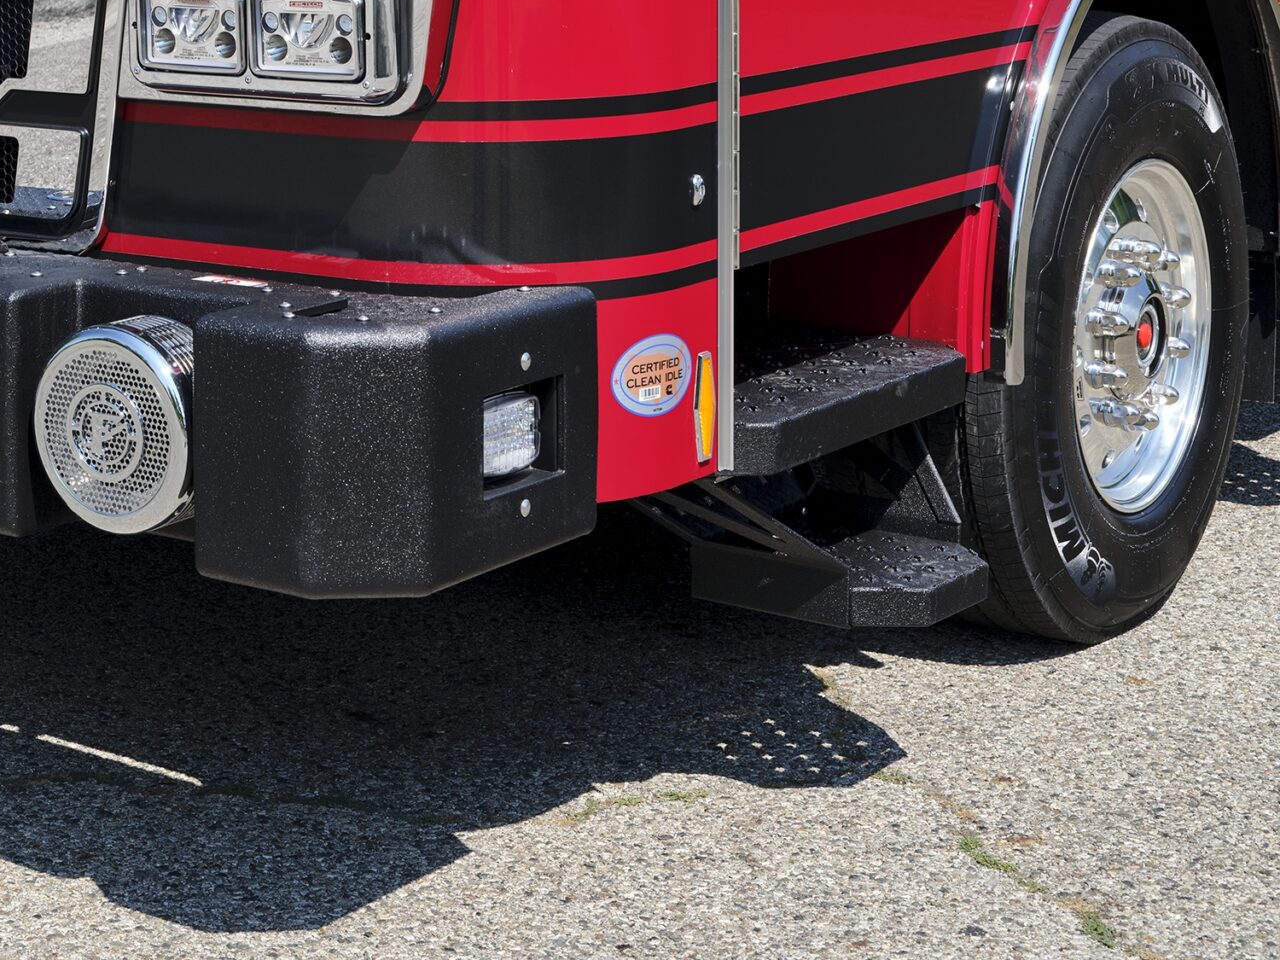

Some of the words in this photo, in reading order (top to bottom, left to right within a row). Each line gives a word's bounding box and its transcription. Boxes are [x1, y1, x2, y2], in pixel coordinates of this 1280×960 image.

[1166, 62, 1209, 106] MULTI
[631, 356, 681, 375] CERTIFIED
[626, 374, 662, 389] CLEAN
[664, 368, 684, 382] IDLE
